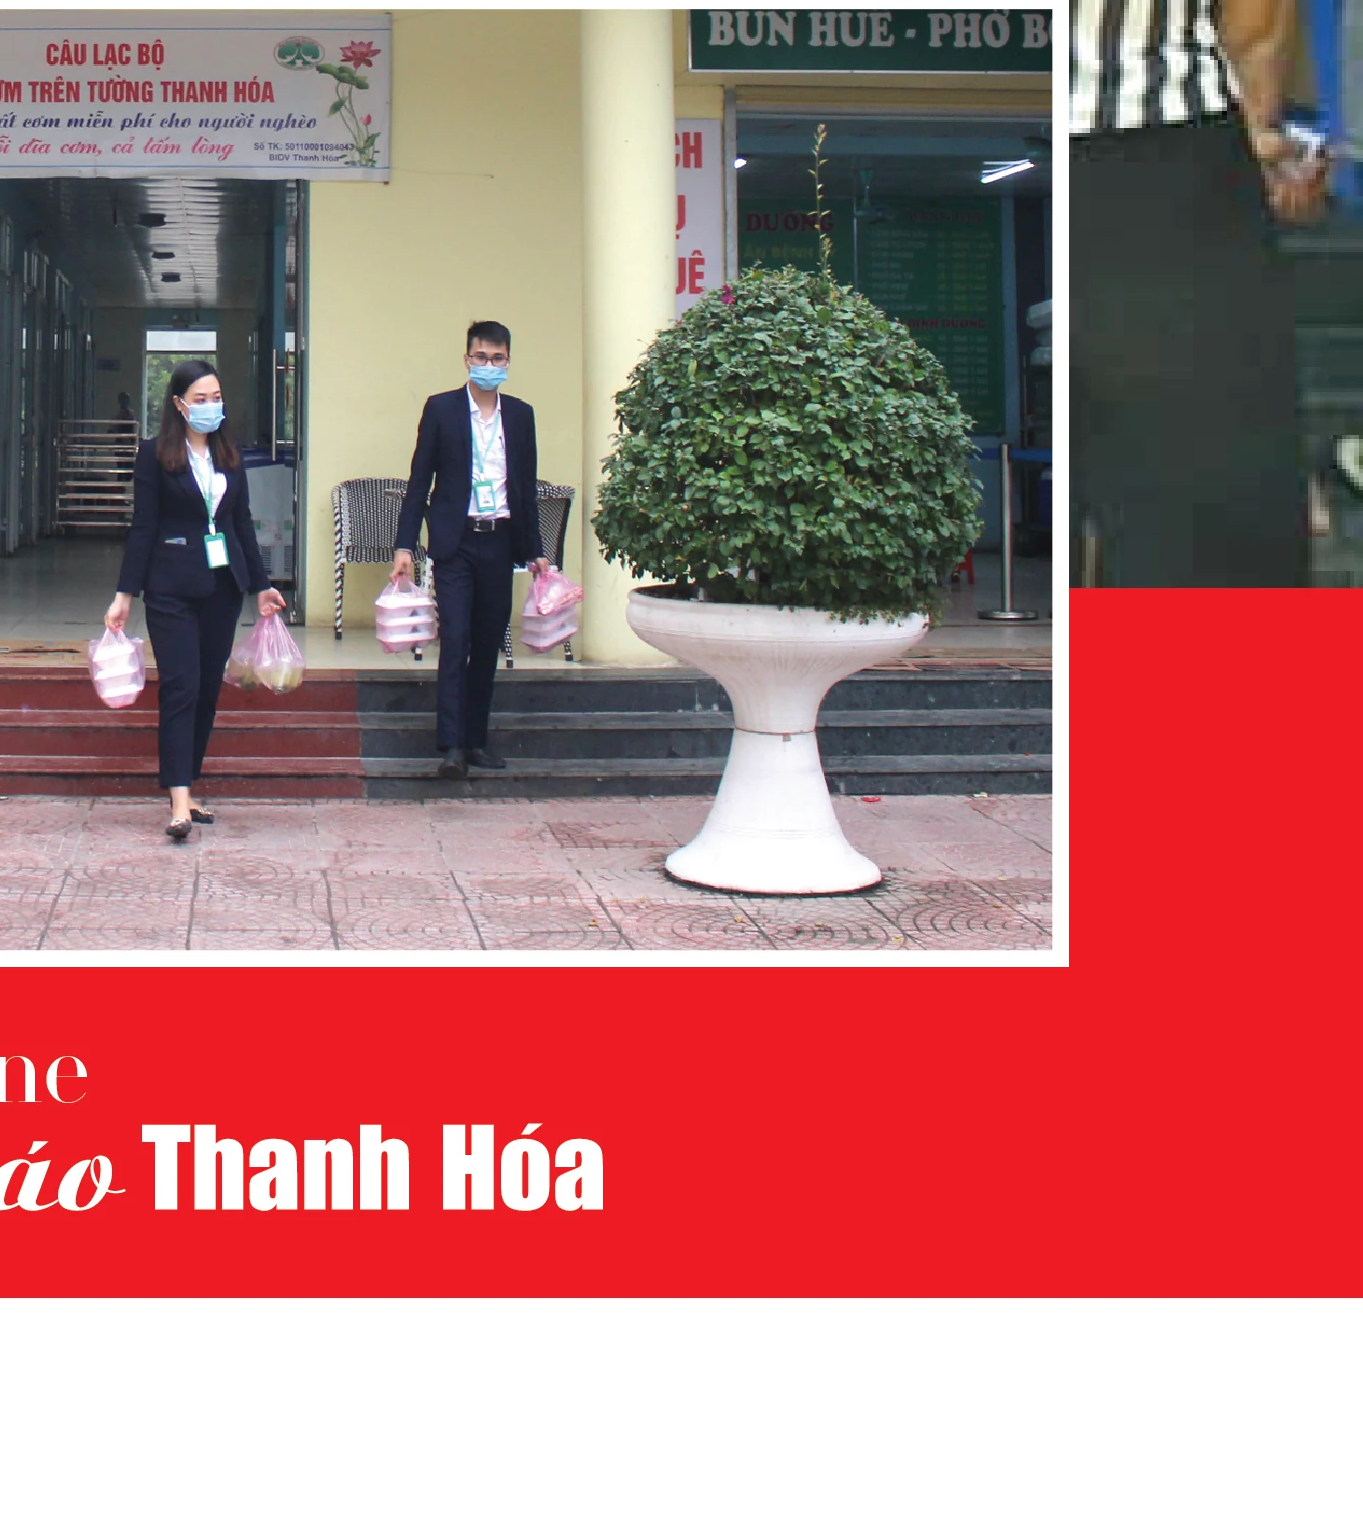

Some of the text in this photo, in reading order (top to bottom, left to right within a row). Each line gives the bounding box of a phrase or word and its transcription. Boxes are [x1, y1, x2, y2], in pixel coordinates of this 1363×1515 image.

[1022, 12, 1053, 48] B
[46, 39, 165, 71] CÂU LẠC BỘ
[28, 75, 80, 103] TRÊN
[87, 75, 153, 103] TƯỜNG
[161, 81, 227, 103] THANH
[234, 75, 275, 103] HÓA
[22, 115, 61, 128] cơm
[67, 110, 115, 128] miễn
[119, 112, 157, 131] phí
[159, 112, 192, 129] cho
[198, 112, 254, 131] người
[111, 136, 135, 155] cả
[143, 136, 182, 155] tấm
[191, 136, 235, 161] lòng
[269, 153, 290, 162] BIDV
[293, 153, 320, 162] Thanh
